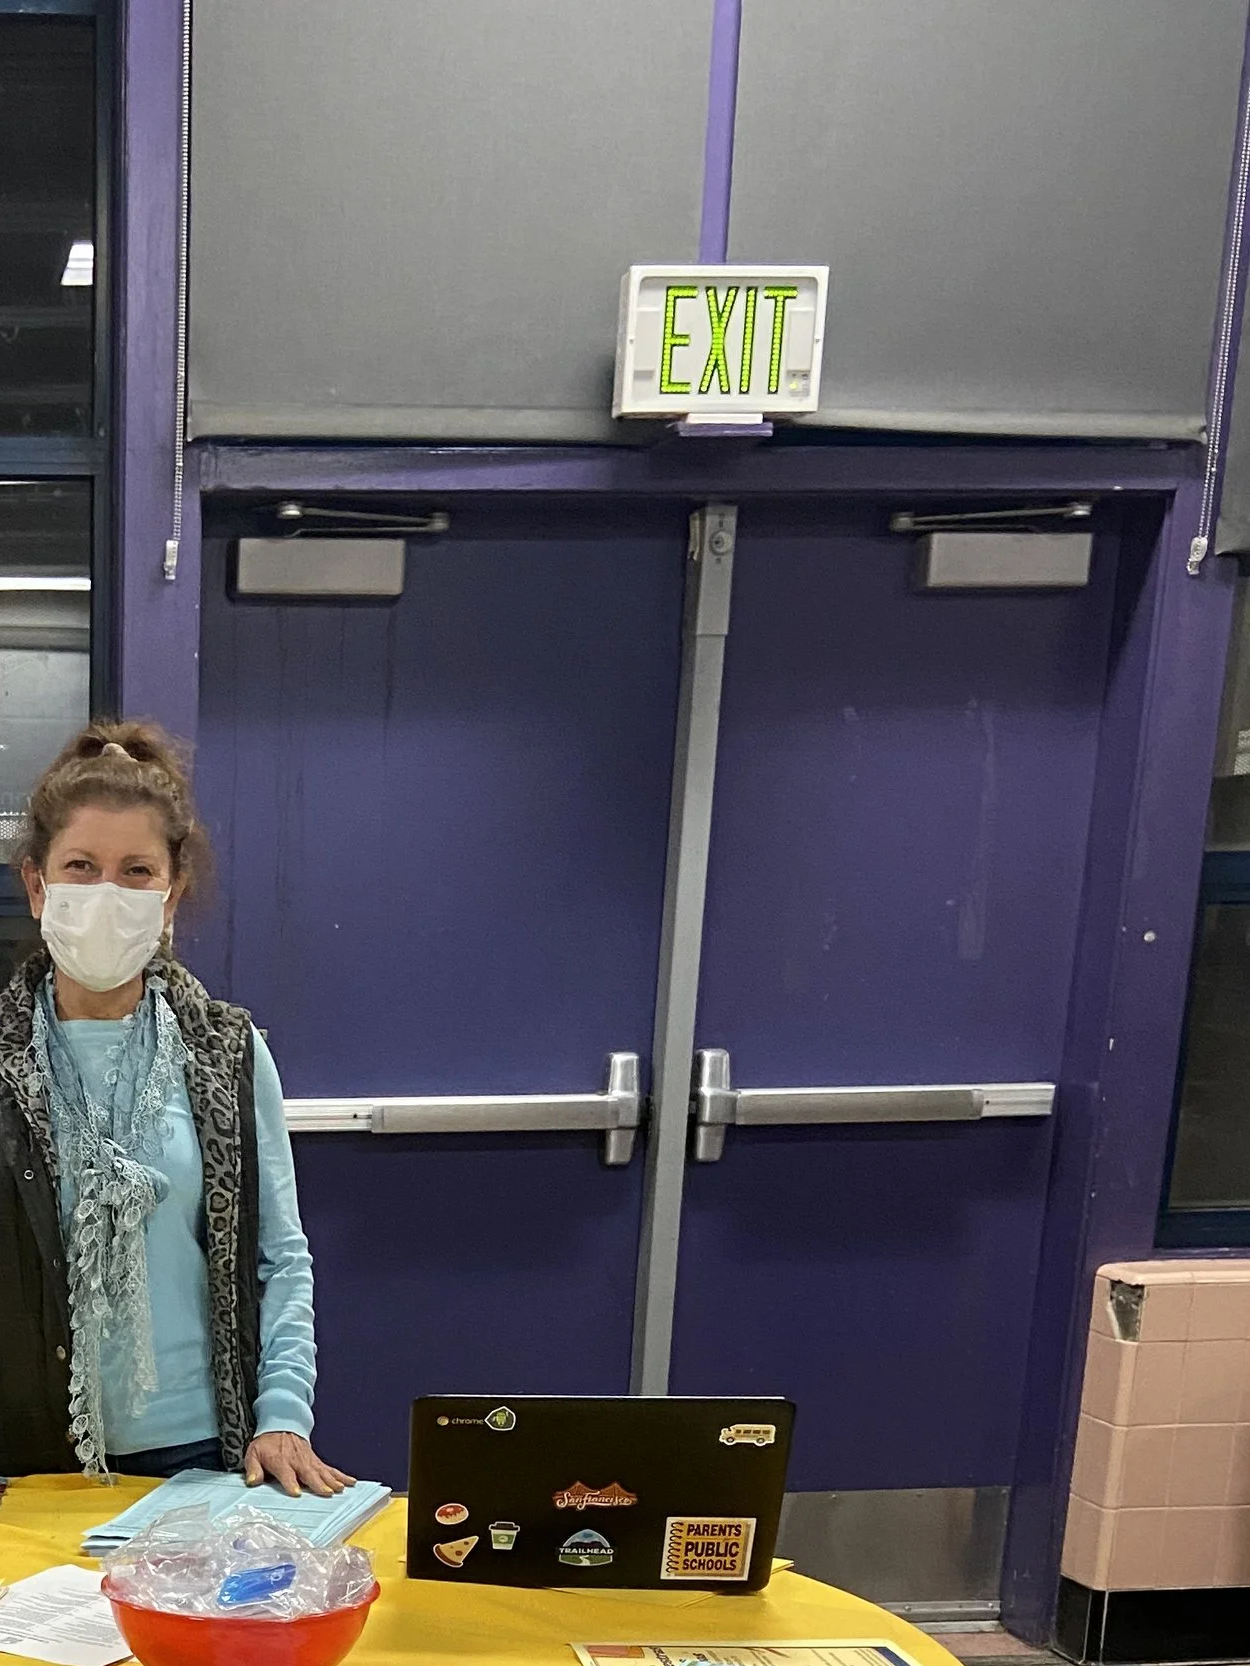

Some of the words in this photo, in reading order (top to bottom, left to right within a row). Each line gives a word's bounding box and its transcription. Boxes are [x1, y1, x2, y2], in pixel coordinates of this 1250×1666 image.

[659, 286, 798, 394] EXIT
[451, 1417, 484, 1425] chrome
[686, 1524, 742, 1537] PARENTS
[559, 1547, 614, 1555] TRAILHEAD
[684, 1541, 740, 1558] PUBLIC
[682, 1559, 737, 1571] SCHOOLS
